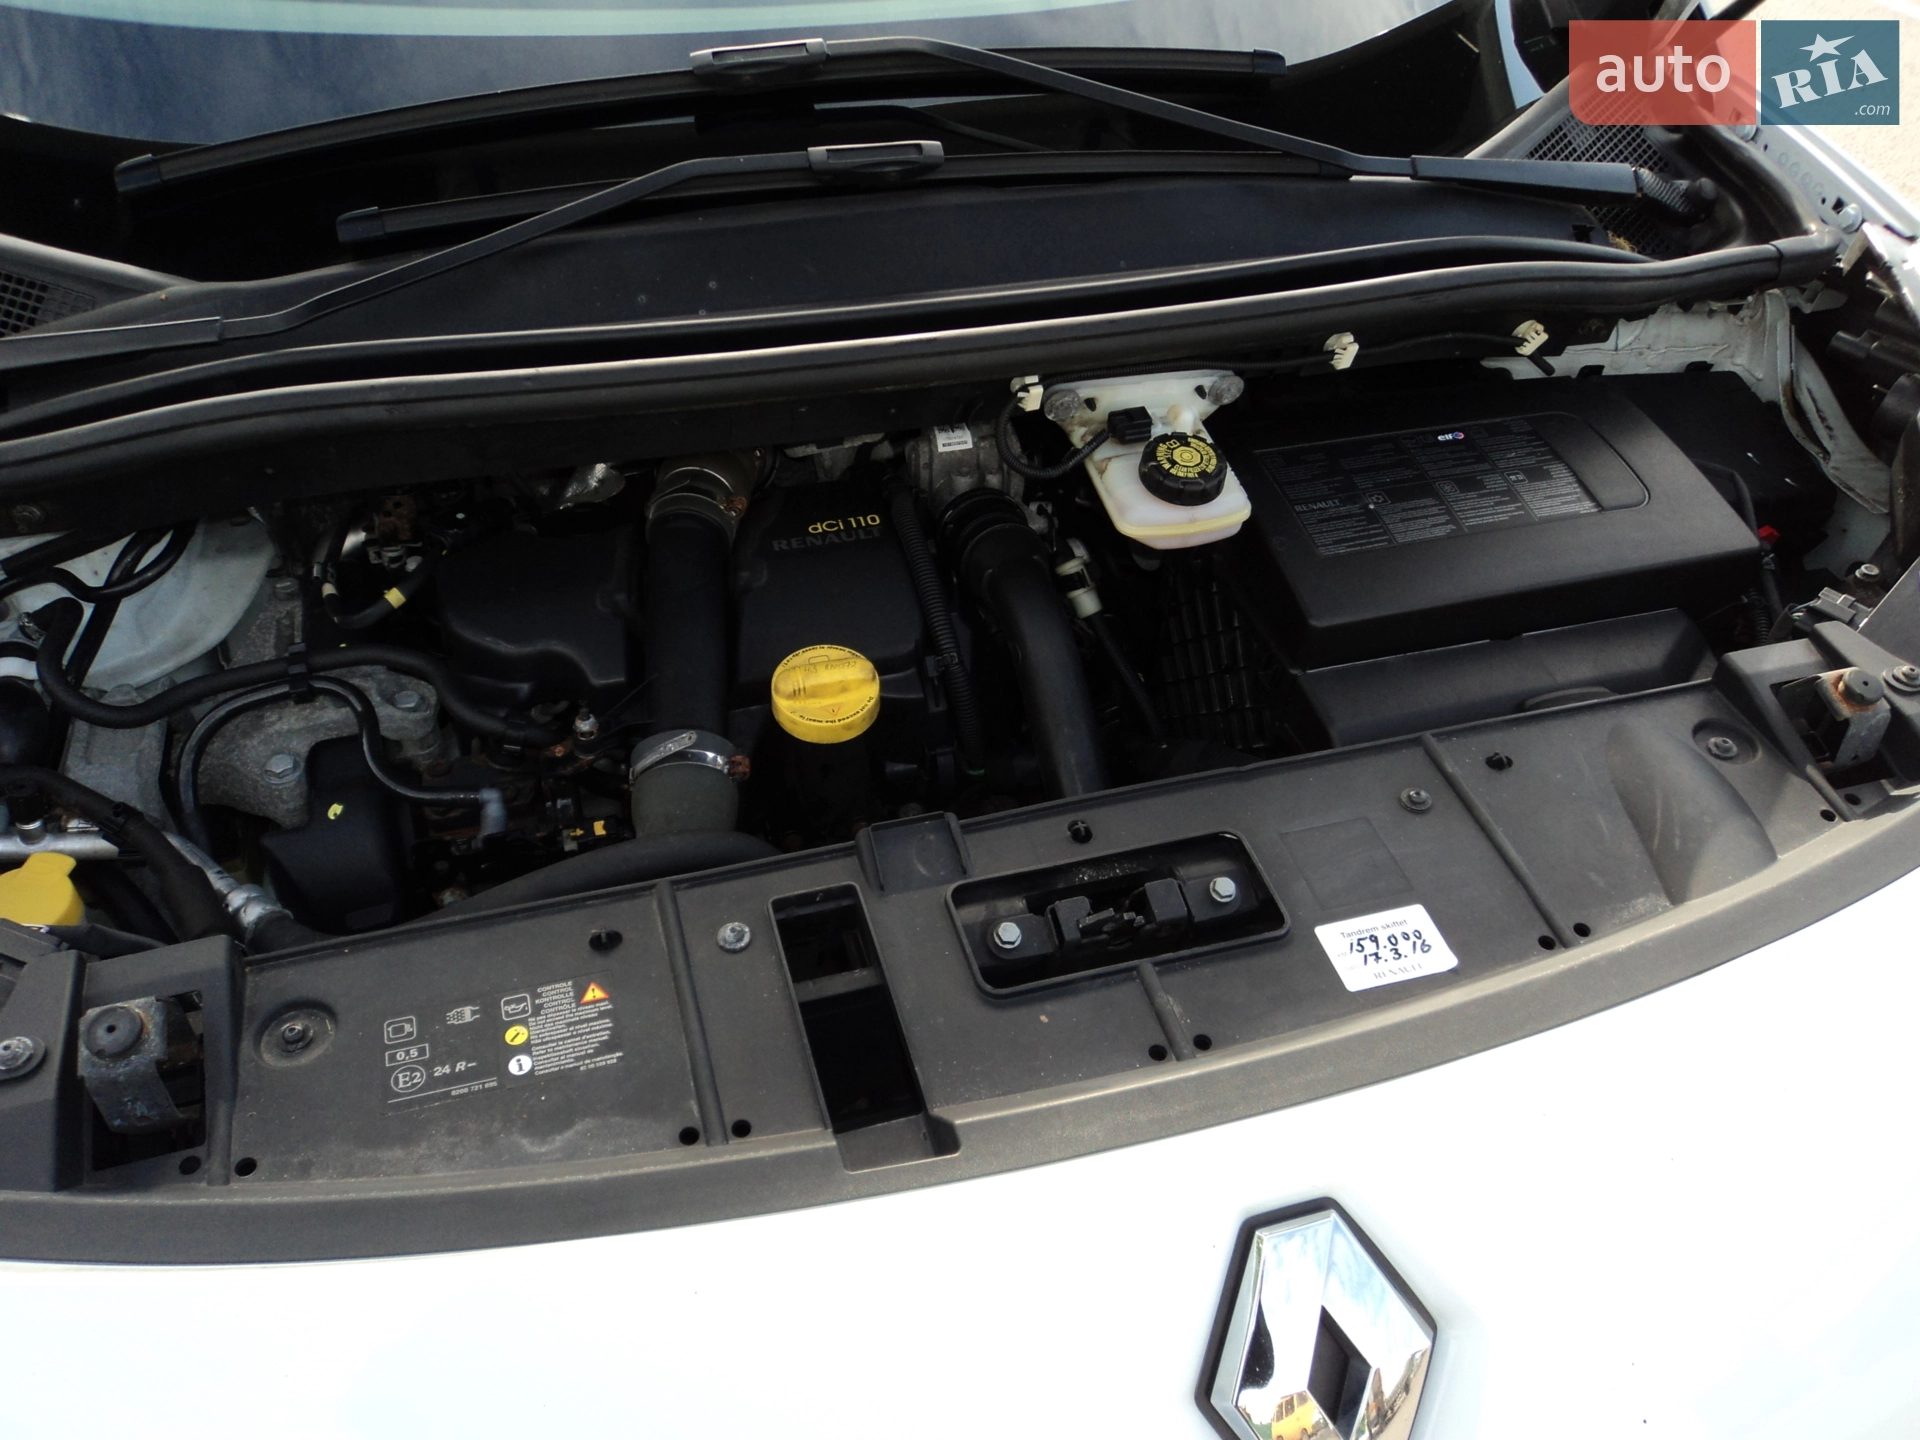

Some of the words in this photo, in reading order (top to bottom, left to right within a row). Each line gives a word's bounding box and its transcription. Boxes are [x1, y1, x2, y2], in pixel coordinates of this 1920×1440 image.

[1294, 499, 1340, 512] RENAULT
[808, 519, 844, 534] dCi
[847, 514, 880, 528] 110
[772, 526, 882, 551] RENAULT
[1340, 925, 1379, 939] Tandrem
[1381, 919, 1408, 930] skiftet
[535, 992, 574, 1004] KONTROLLE
[433, 1065, 451, 1077] 24
[397, 1072, 422, 1089] E2
